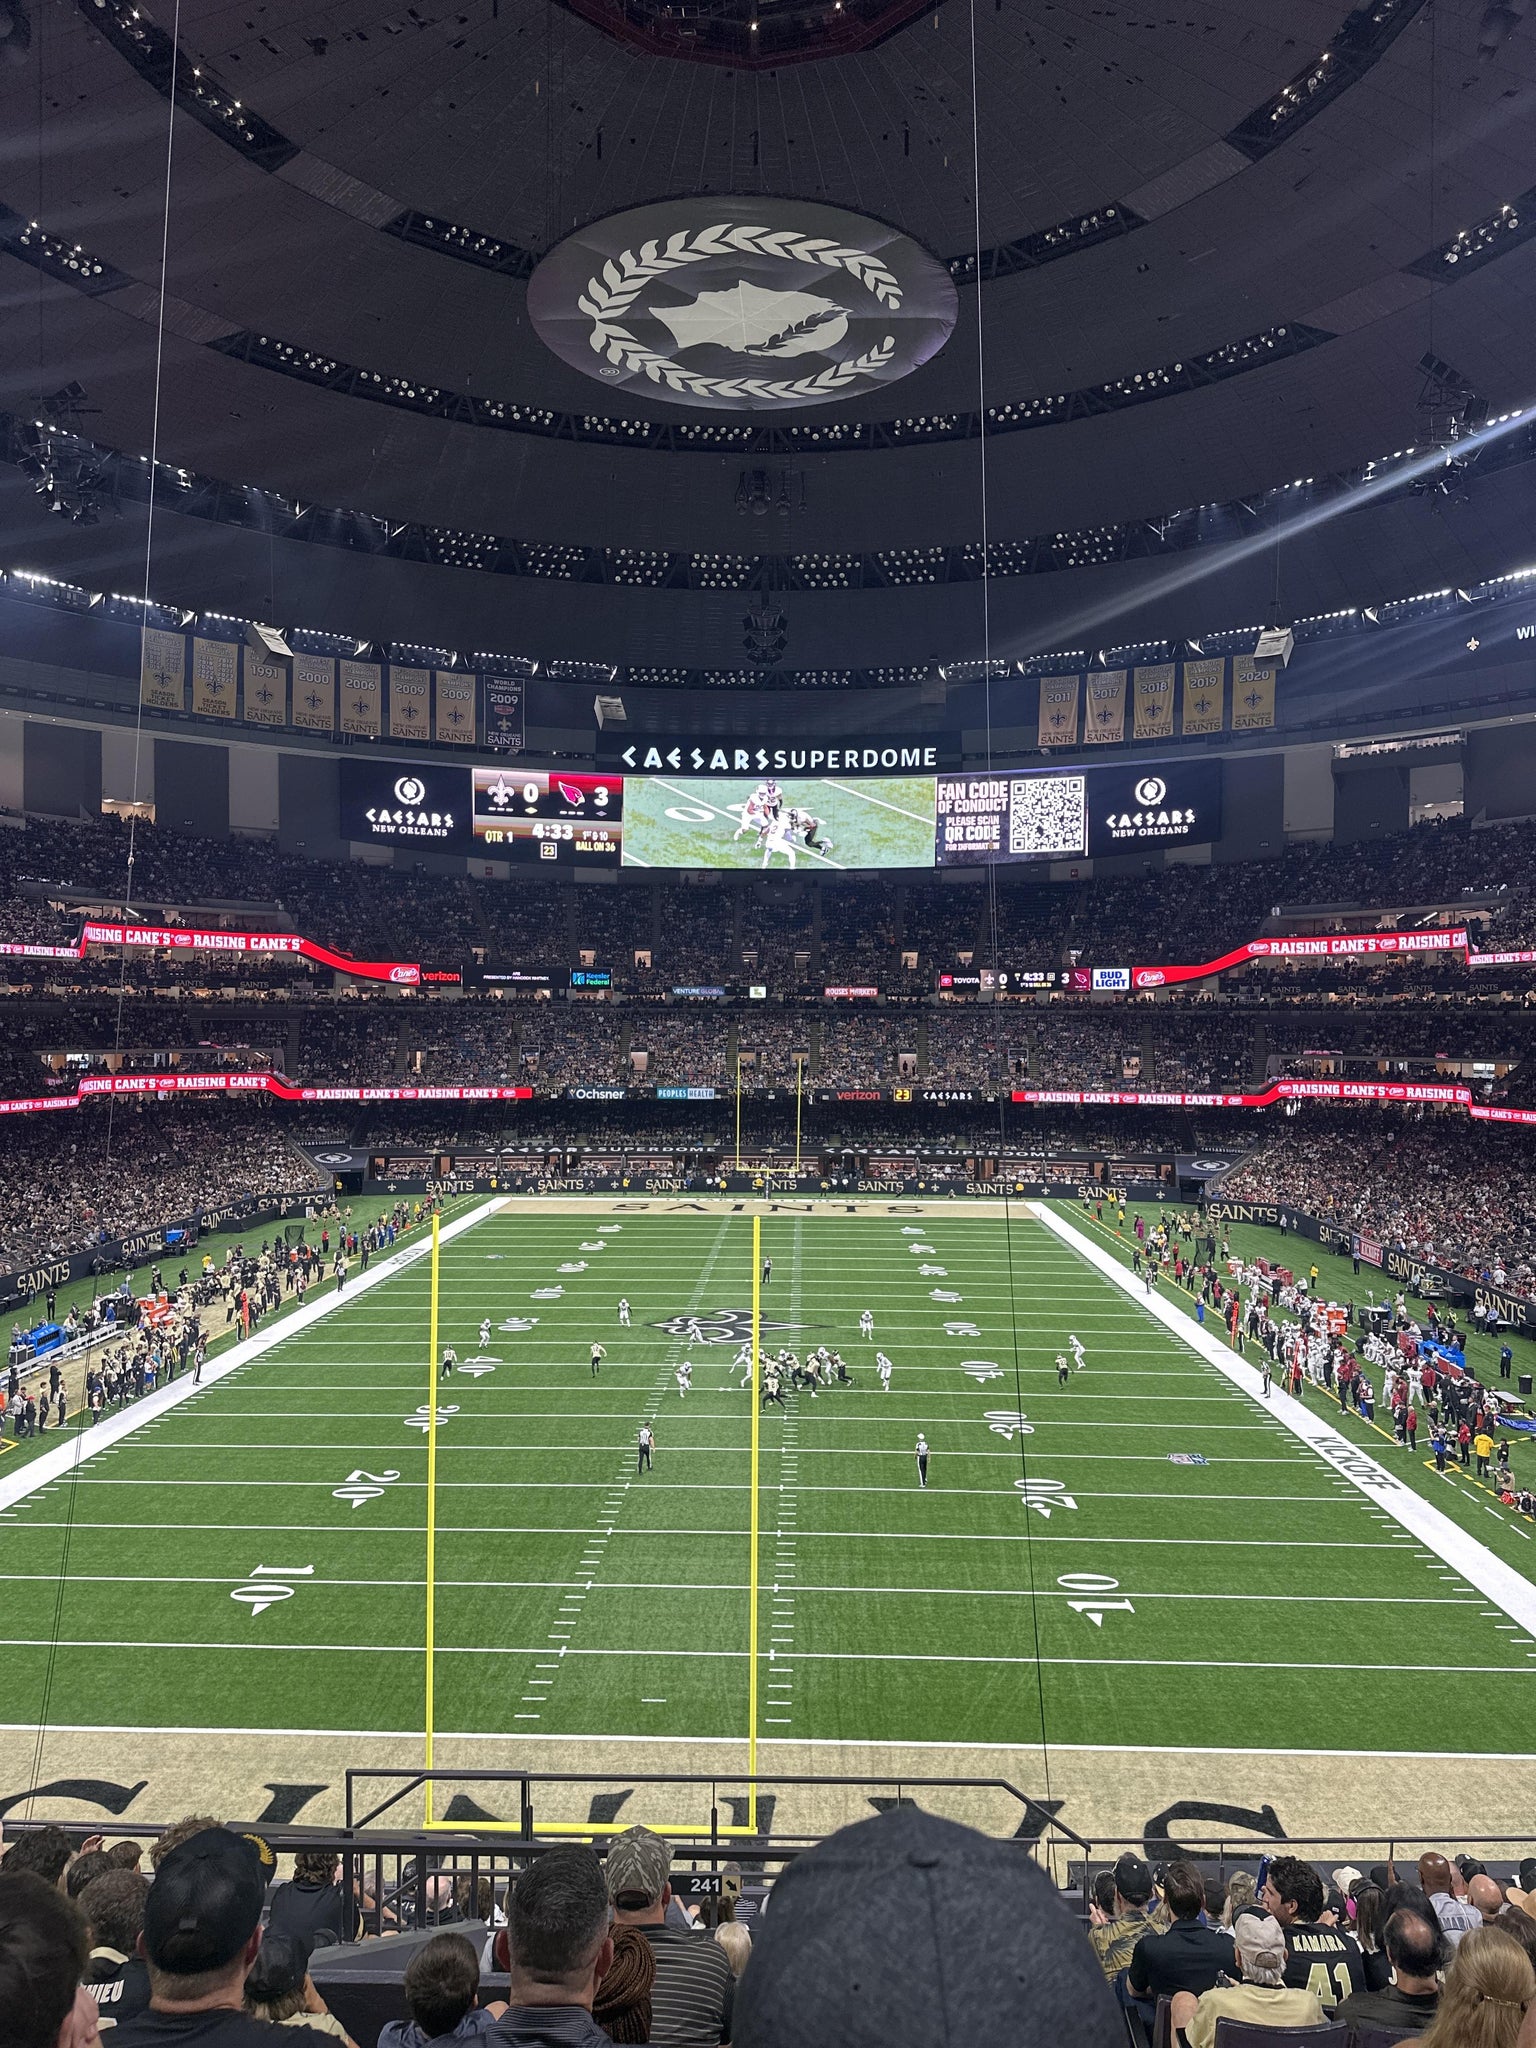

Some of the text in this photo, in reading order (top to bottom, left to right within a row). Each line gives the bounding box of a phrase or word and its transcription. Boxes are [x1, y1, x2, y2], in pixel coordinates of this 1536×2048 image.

[251, 665, 279, 679] 1991
[298, 671, 330, 684] 2000
[1240, 670, 1270, 683] 2020
[345, 678, 377, 692] 2006
[1190, 676, 1217, 688] 2019
[395, 684, 425, 696] 2009
[486, 684, 521, 692] CHAMPIONS
[1094, 688, 1119, 699] 2017
[1140, 682, 1168, 694] 2018
[442, 689, 470, 700] 2009
[490, 693, 518, 704] 2009
[1047, 692, 1072, 703] 2011
[246, 712, 283, 724] SAINTS
[295, 716, 332, 729] SAINTS
[1234, 717, 1272, 728] SAINTS
[343, 722, 378, 734] SAINTS
[392, 728, 428, 738] SAINTS
[1136, 726, 1171, 738] SAINTS
[1185, 722, 1220, 734] SAINTS
[440, 732, 472, 742] SAINTS
[488, 736, 520, 746] SAINTS
[1041, 735, 1074, 744] SAINTS
[1087, 732, 1121, 742] SAINTS
[621, 746, 937, 770] CAESARS SUPERDOME
[523, 782, 538, 803] 0
[938, 780, 1008, 800] FAN CODE
[594, 786, 608, 806] 3
[938, 798, 1008, 814] OF CONDUCT
[365, 810, 454, 828] CAESARS
[946, 815, 1000, 826] PLEASE SCAN
[1106, 808, 1196, 828] CAESARS
[372, 824, 448, 837] NEW ORLEANS
[532, 824, 574, 840] 4:33
[599, 832, 608, 840] 10
[945, 825, 1000, 844] QR CODE
[1112, 826, 1189, 838] NEW ORLEANS
[485, 830, 514, 843] QTR 1
[544, 846, 554, 855] 23
[576, 841, 616, 852] BALL ON 36
[126, 930, 170, 945] CANE'S
[194, 933, 301, 950] RAISING CANE'S
[1398, 934, 1449, 949] RAISING
[24, 946, 54, 956] RAISING
[1270, 938, 1376, 954] RAISING CANE'S
[1495, 952, 1520, 963] CANE'S
[421, 971, 460, 981] verizon
[999, 974, 1007, 984] 0
[1023, 973, 1044, 981] 4:33
[1061, 973, 1070, 984] 3
[1100, 971, 1122, 980] BUD
[174, 979, 204, 987] SAINTS
[240, 981, 269, 989] SAINTS
[1096, 978, 1126, 988] LIGHT
[1403, 984, 1432, 992] SAINTS
[825, 988, 878, 996] ROUSES MARKETS
[1338, 985, 1367, 993] SAINTS
[115, 1079, 156, 1090] CANE'S
[177, 1077, 267, 1088] RAISING CANE'S
[317, 1089, 400, 1099] RAISING CANE'S
[418, 1089, 498, 1098] RAISING CANE'S
[576, 1089, 624, 1100] Ochsner
[658, 1090, 686, 1098] PEOPLES
[836, 1091, 880, 1099] verizon
[896, 1090, 909, 1099] 23
[1292, 1084, 1385, 1096] RAISING CANE'S
[1407, 1087, 1454, 1099] RAISING
[923, 1092, 972, 1100] CAESARS
[1038, 1093, 1119, 1103] RAISING CANE'S
[1138, 1094, 1222, 1105] RAISING CANE'S
[11, 1101, 33, 1110] CANE'S
[43, 1099, 68, 1108] RAISING
[1491, 1110, 1511, 1119] CANE'S
[936, 1150, 1057, 1158] SUPERDOME
[426, 1180, 474, 1191] SAINTS
[537, 1179, 584, 1190] SAINTS
[858, 1181, 904, 1192] SAINTS
[966, 1184, 1013, 1195] SAINTS
[1078, 1187, 1127, 1198] SAINTS
[612, 1202, 924, 1214] SAINTS
[1210, 1203, 1278, 1223] SAINTS
[16, 1260, 70, 1293] SAINTS
[456, 1355, 503, 1374] 40
[960, 1360, 1005, 1378] 40
[404, 1404, 460, 1428] 30
[983, 1410, 1035, 1434] 30
[1308, 1436, 1402, 1492] KICKOFF
[332, 1469, 400, 1499] 20
[1014, 1478, 1078, 1510] 20
[229, 1564, 315, 1603] 10
[1056, 1573, 1135, 1613] 10
[690, 1878, 719, 1892] 241
[1292, 1934, 1347, 1952] KAMARA
[1306, 1962, 1353, 2006] 41
